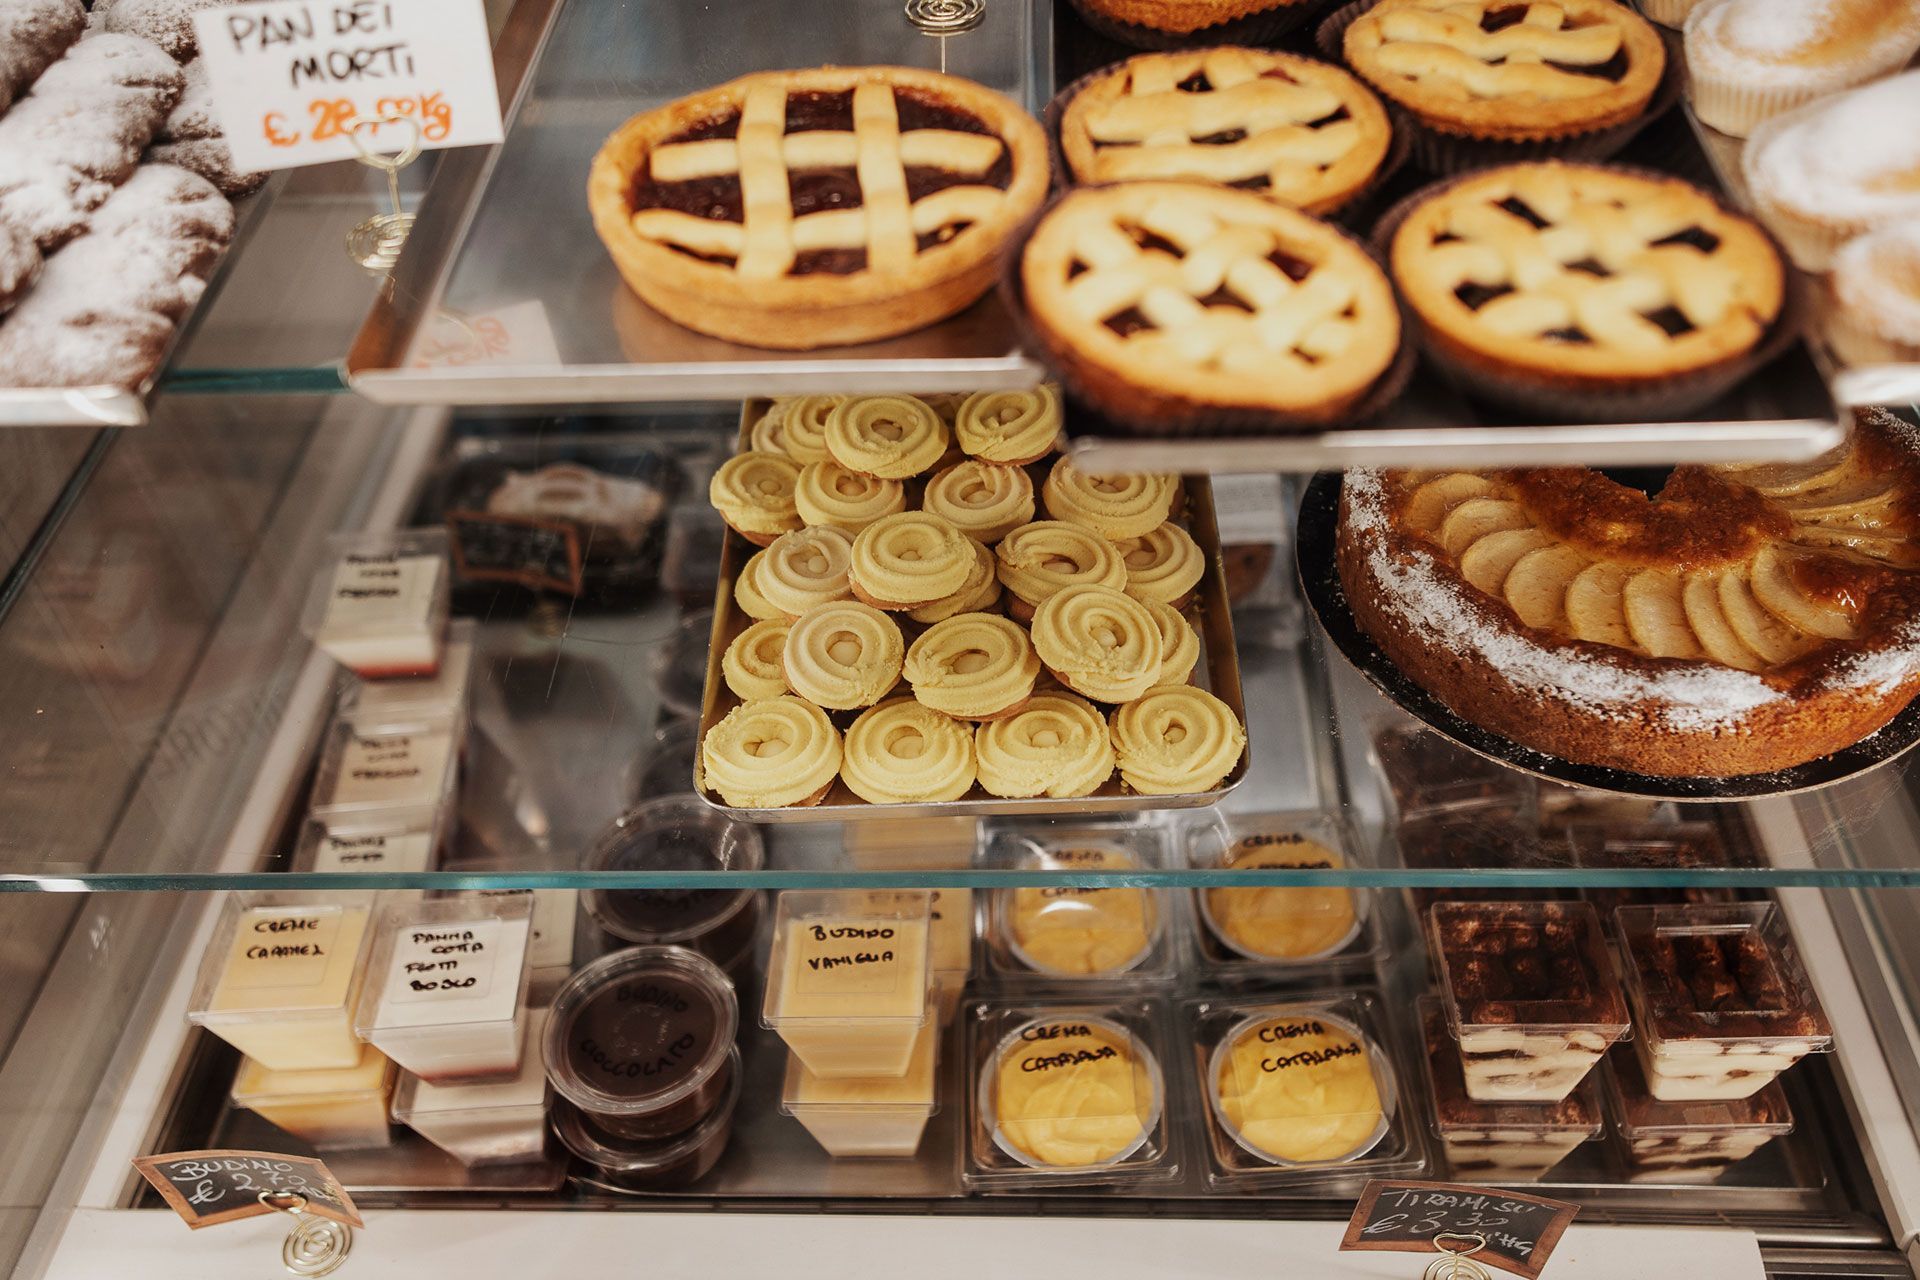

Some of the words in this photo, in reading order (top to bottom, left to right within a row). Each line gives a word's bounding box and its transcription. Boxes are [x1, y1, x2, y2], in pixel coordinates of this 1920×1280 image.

[227, 7, 313, 50] PAN
[333, 2, 393, 35] DEI
[290, 42, 416, 88] MORTI
[263, 111, 300, 147] €
[412, 931, 473, 944] PANNA
[809, 925, 894, 941] BUDINO
[808, 951, 894, 970] VANIGLIA
[1021, 1025, 1092, 1042] CREMA
[1258, 1021, 1325, 1043] CREMA
[580, 1033, 695, 1078] CIOCCOLATO
